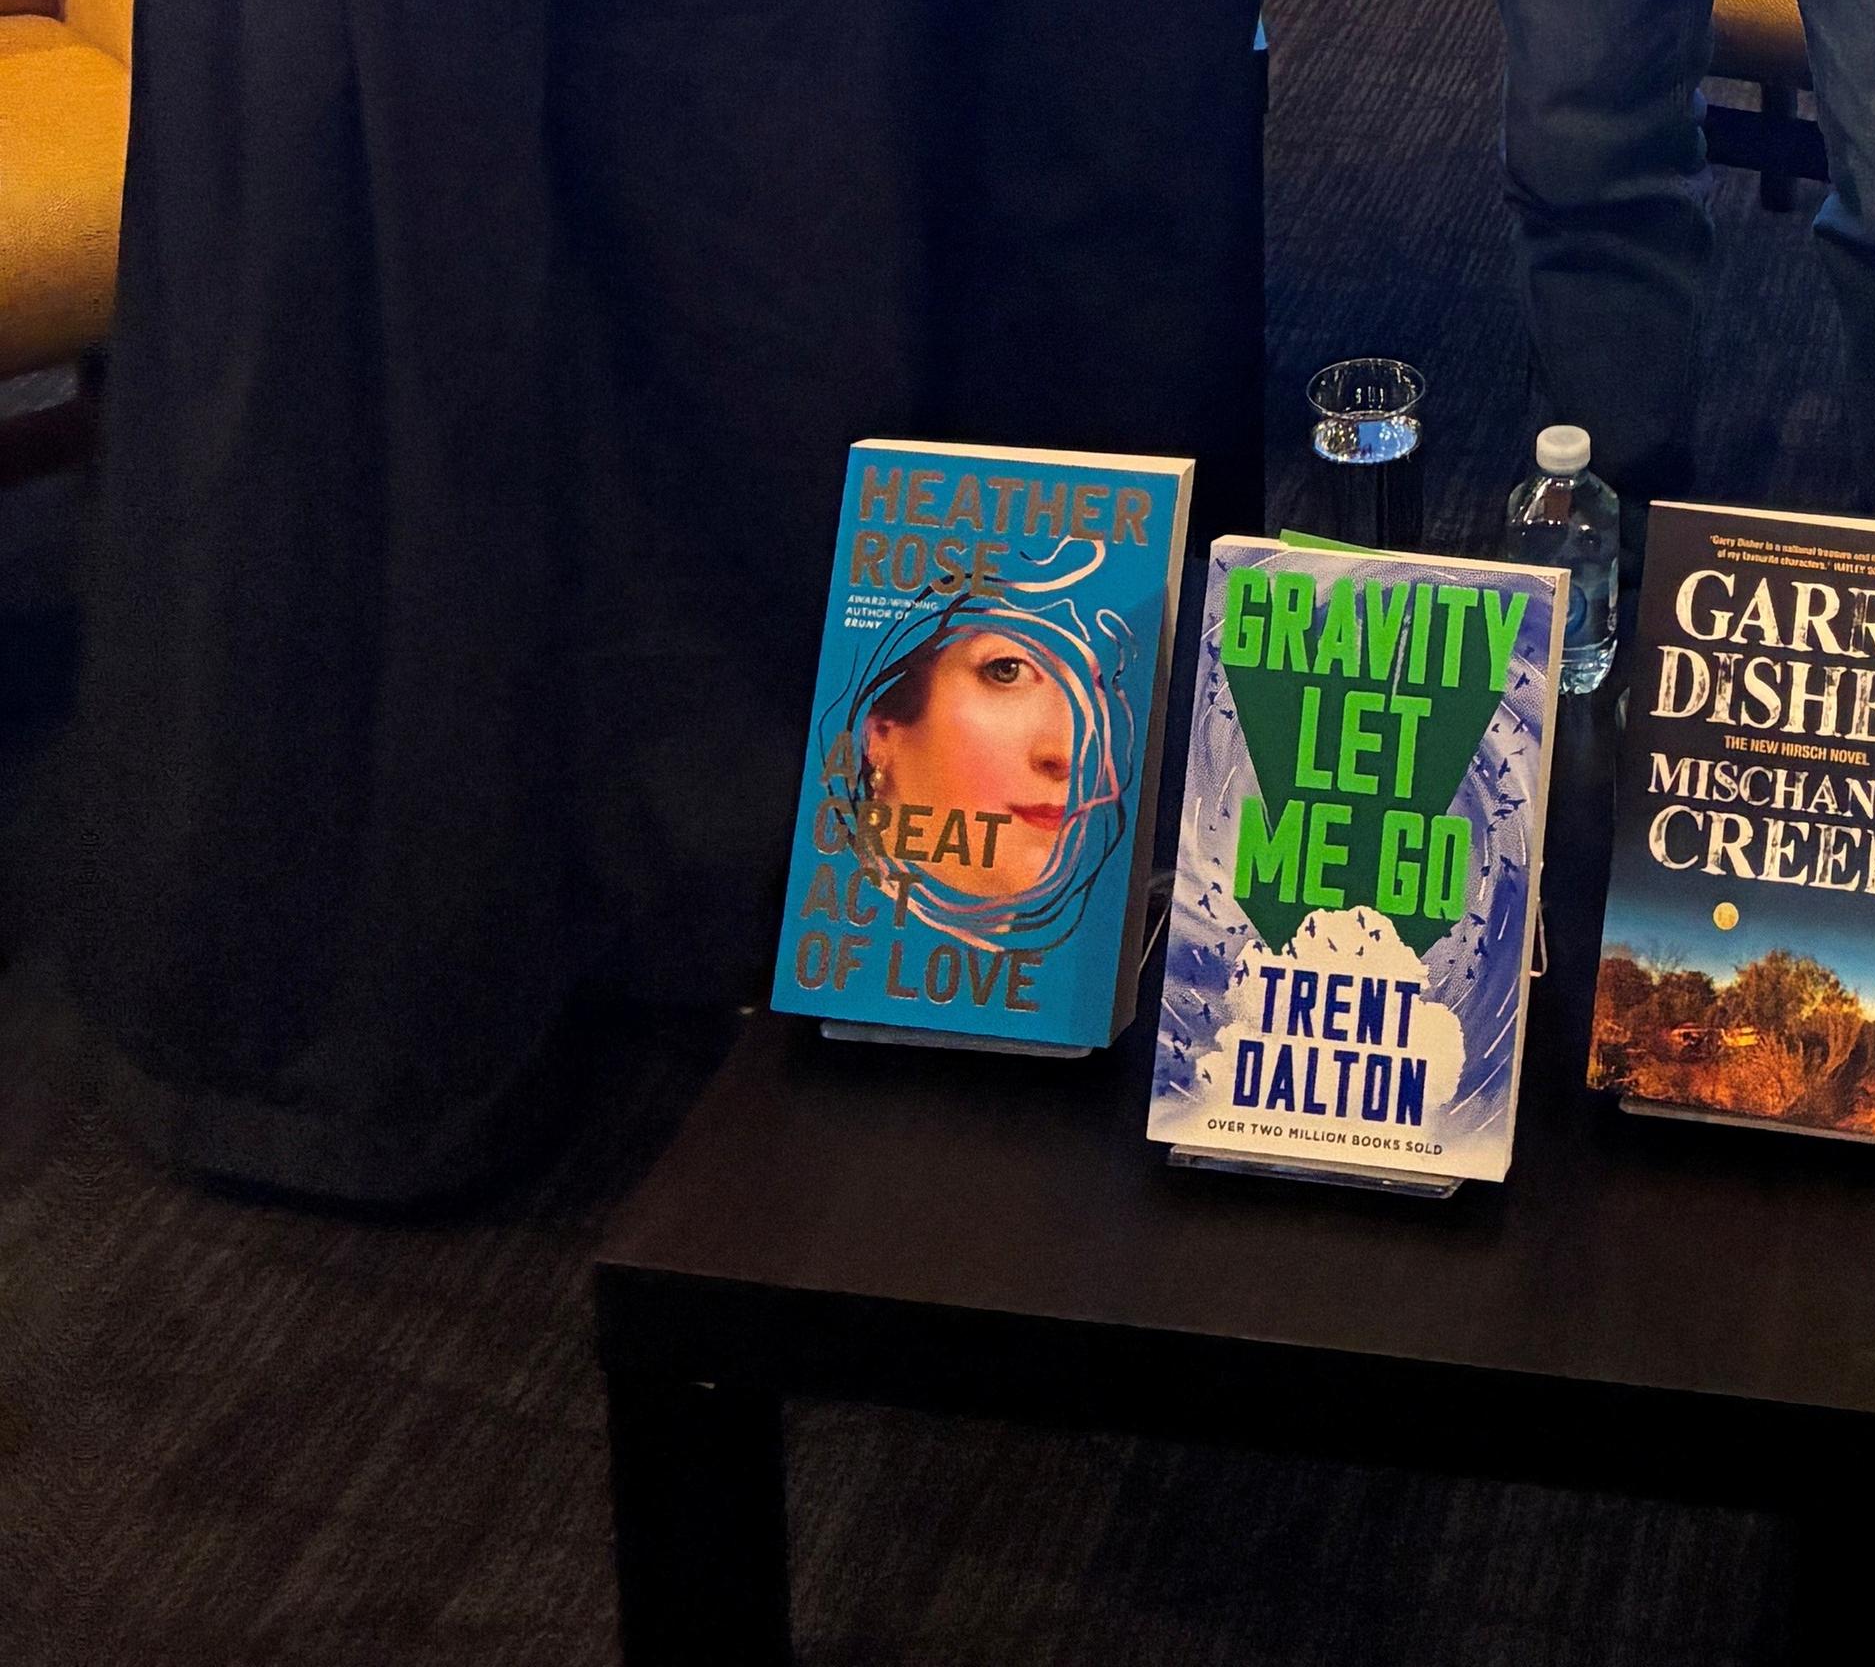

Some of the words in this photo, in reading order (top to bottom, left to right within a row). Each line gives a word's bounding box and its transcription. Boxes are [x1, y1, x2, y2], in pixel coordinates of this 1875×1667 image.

[858, 465, 1154, 547] HEATHER
[849, 530, 1011, 598] ROSE
[845, 607, 892, 618] AUTHOR
[1220, 566, 1530, 692] GRAVITY
[820, 730, 860, 791] A
[1295, 685, 1433, 799] LET
[1724, 734, 1748, 751] THE
[1750, 738, 1779, 754] NEW
[1781, 742, 1827, 760] HIRSCH
[1830, 748, 1870, 766] NOVEL
[813, 795, 1013, 869] GREAT
[1233, 795, 1353, 909] ME
[1376, 810, 1473, 922] GO
[800, 862, 921, 929] ACT
[794, 931, 871, 991] OF
[885, 939, 1044, 1013] LOVE
[1259, 965, 1421, 1049] TRENT
[1232, 1039, 1428, 1127] DALTON
[1207, 1118, 1244, 1133] OVER
[1251, 1123, 1283, 1137] TWO
[1289, 1127, 1347, 1144] MILLION
[1352, 1135, 1400, 1151] BOOKS
[1405, 1140, 1443, 1156] SOLD
